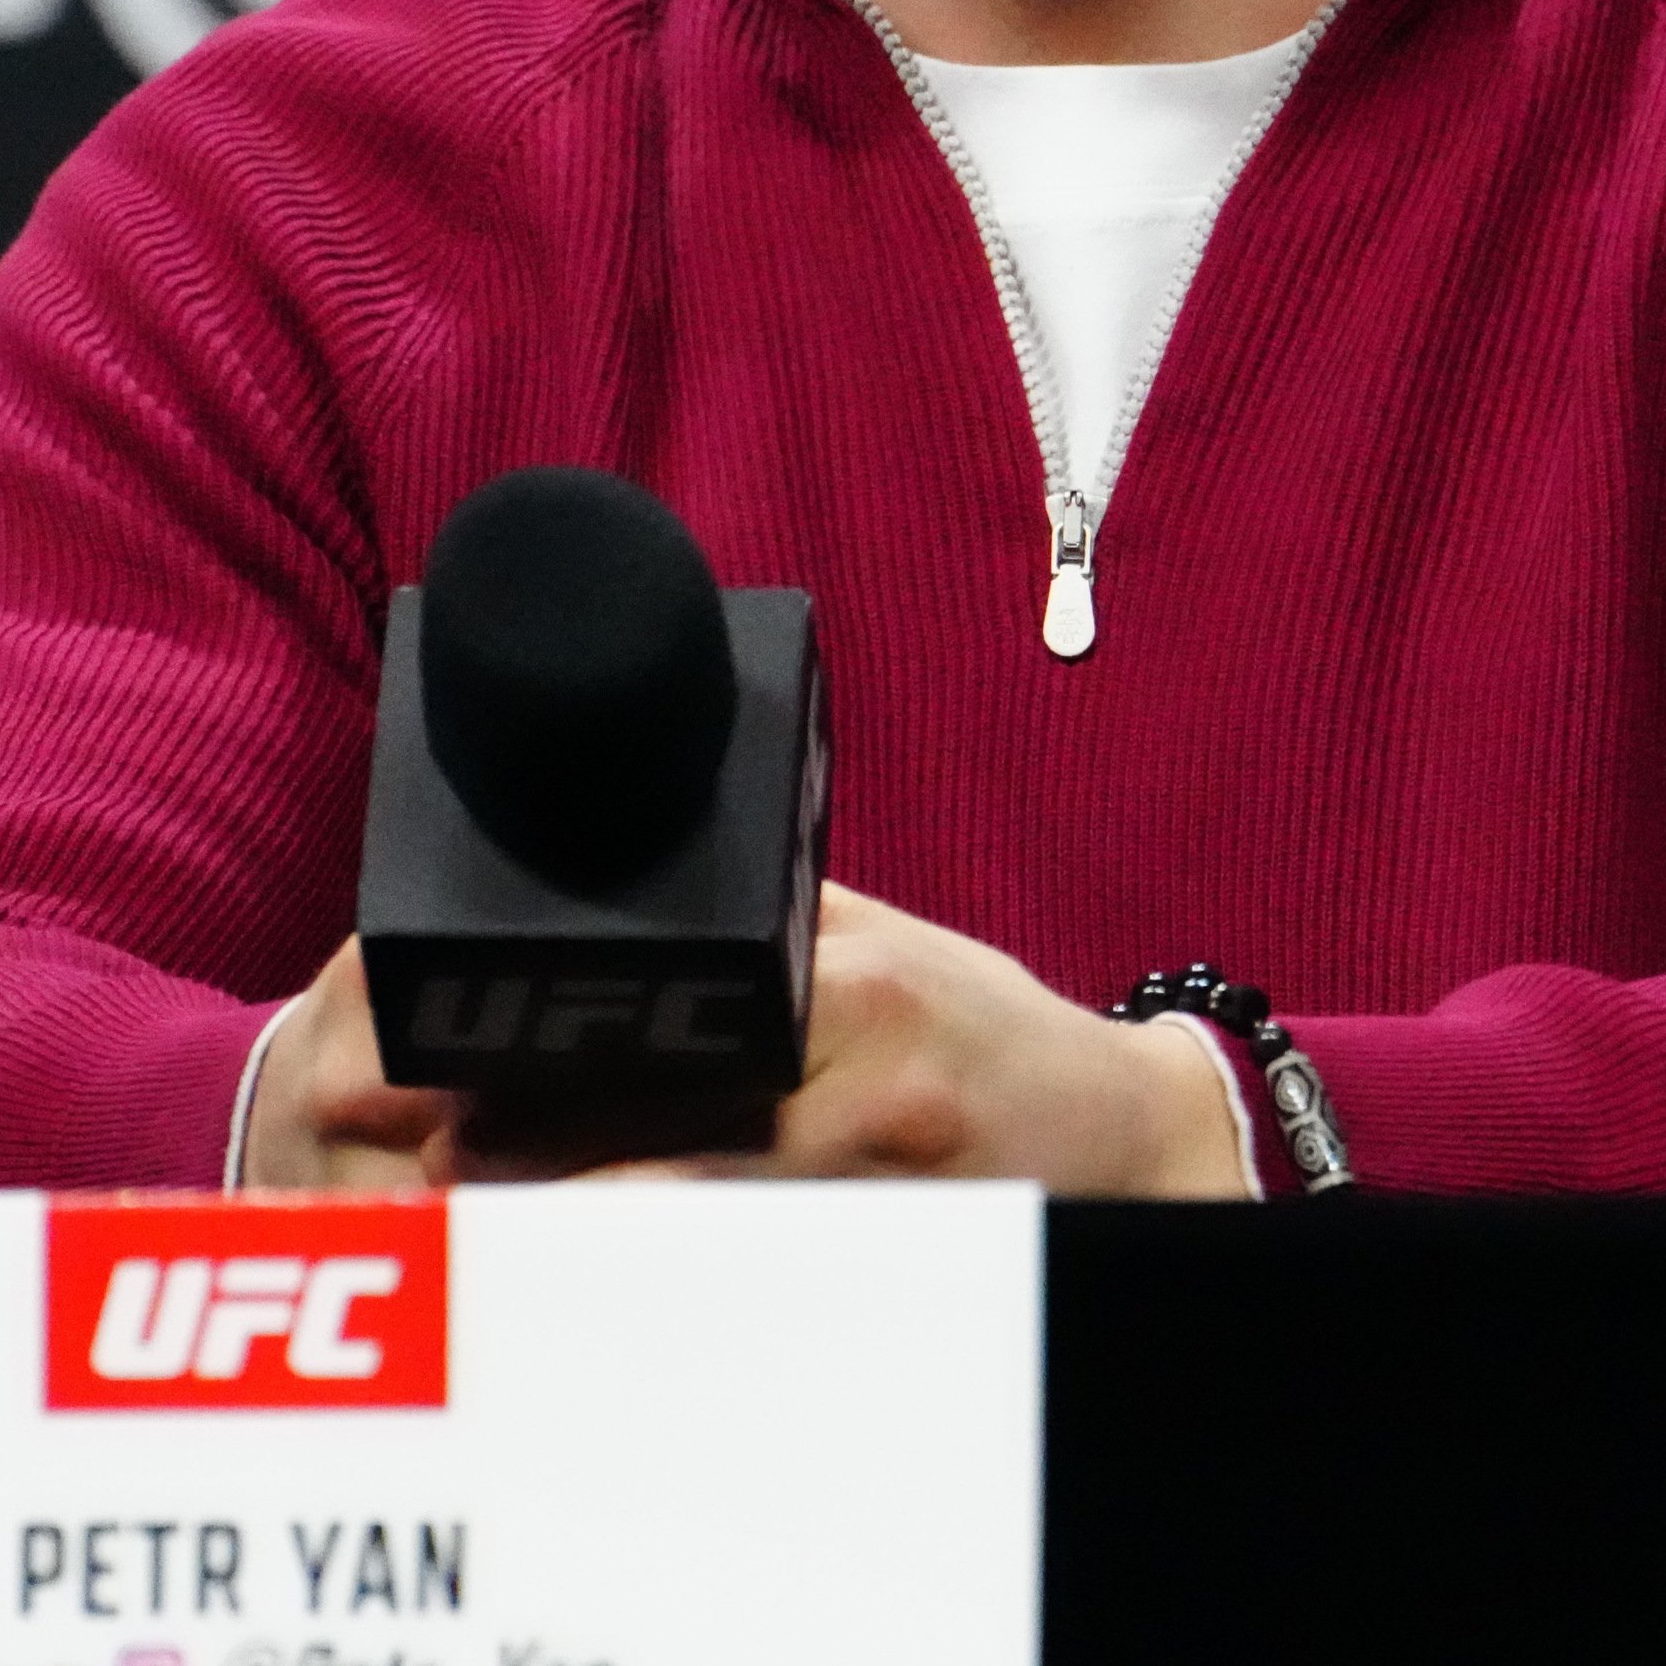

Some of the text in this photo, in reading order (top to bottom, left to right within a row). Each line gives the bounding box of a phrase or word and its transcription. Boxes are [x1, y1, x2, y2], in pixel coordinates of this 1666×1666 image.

[411, 978, 755, 1052] UFC
[89, 1256, 403, 1380] UFC
[17, 1520, 467, 1616] PETR YAN
